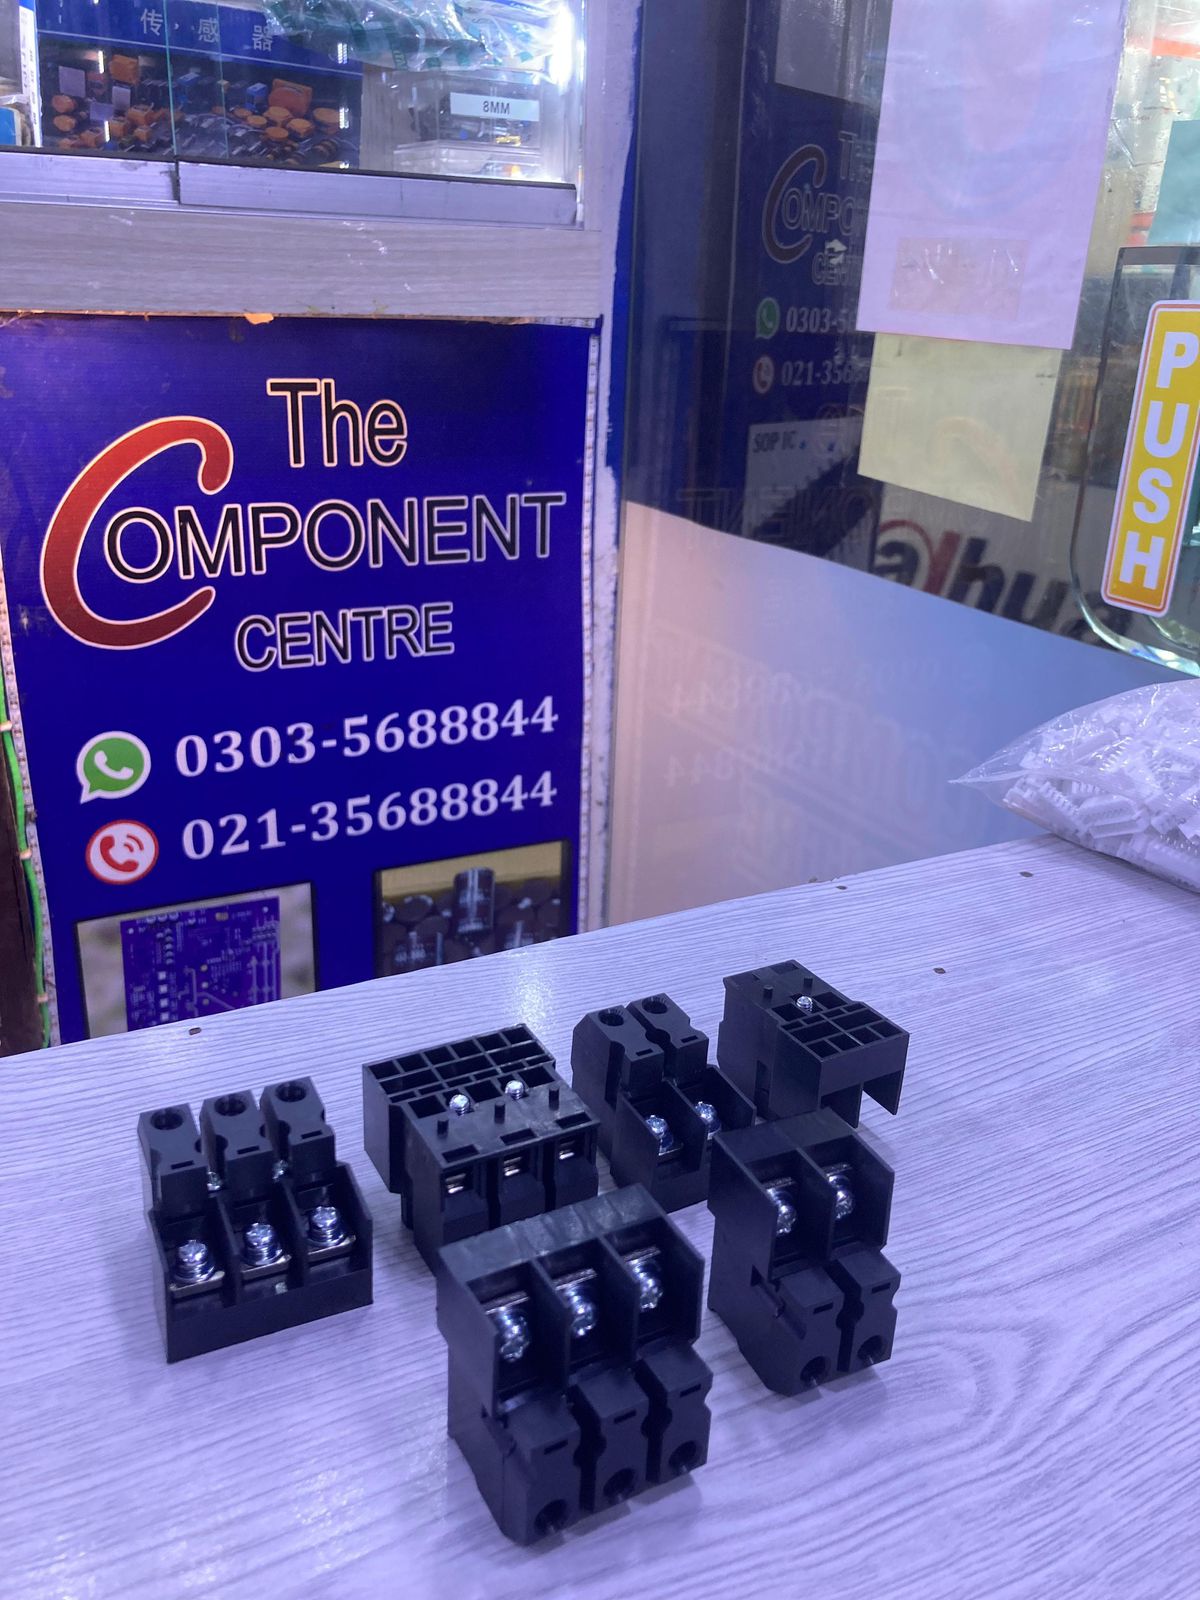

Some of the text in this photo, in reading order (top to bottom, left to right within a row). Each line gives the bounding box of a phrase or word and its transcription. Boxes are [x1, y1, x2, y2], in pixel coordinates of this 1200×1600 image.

[267, 377, 408, 468] The
[1118, 331, 1200, 590] PUSH
[39, 415, 566, 650] COMPONENT
[234, 602, 455, 672] CENTRE
[175, 695, 559, 778] 0303-5688844
[181, 770, 558, 860] 021-35688844
